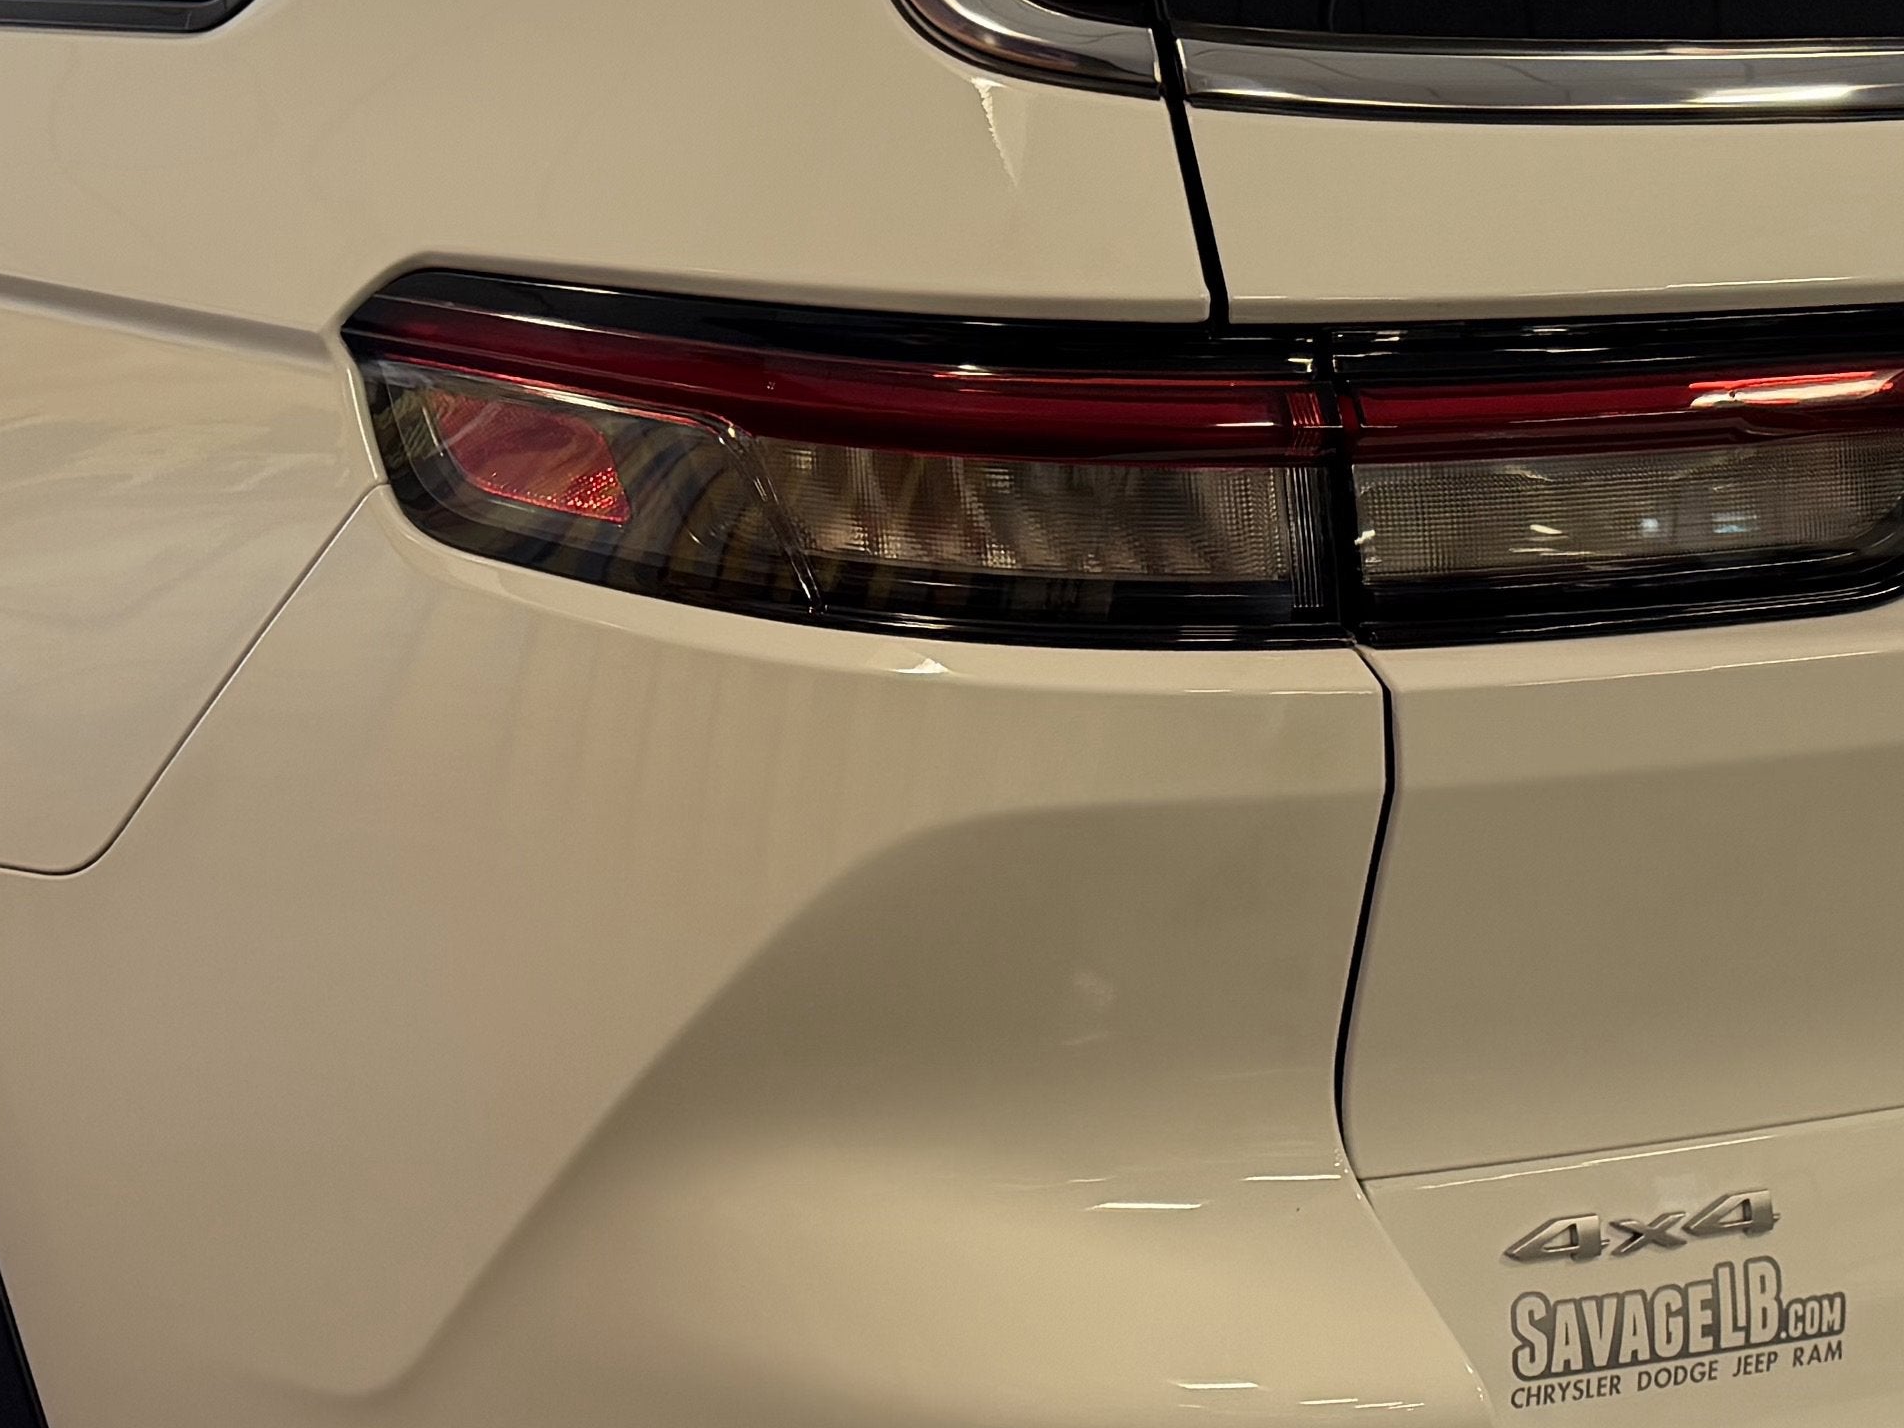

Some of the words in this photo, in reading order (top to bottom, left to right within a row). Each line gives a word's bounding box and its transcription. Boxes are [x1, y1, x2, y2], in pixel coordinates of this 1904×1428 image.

[1501, 1188, 1781, 1263] 4x4
[1511, 1375, 1622, 1409] CHRYSLER
[1637, 1362, 1719, 1393] DODGE
[1733, 1350, 1779, 1379] JEEP
[1793, 1340, 1844, 1368] RAM
